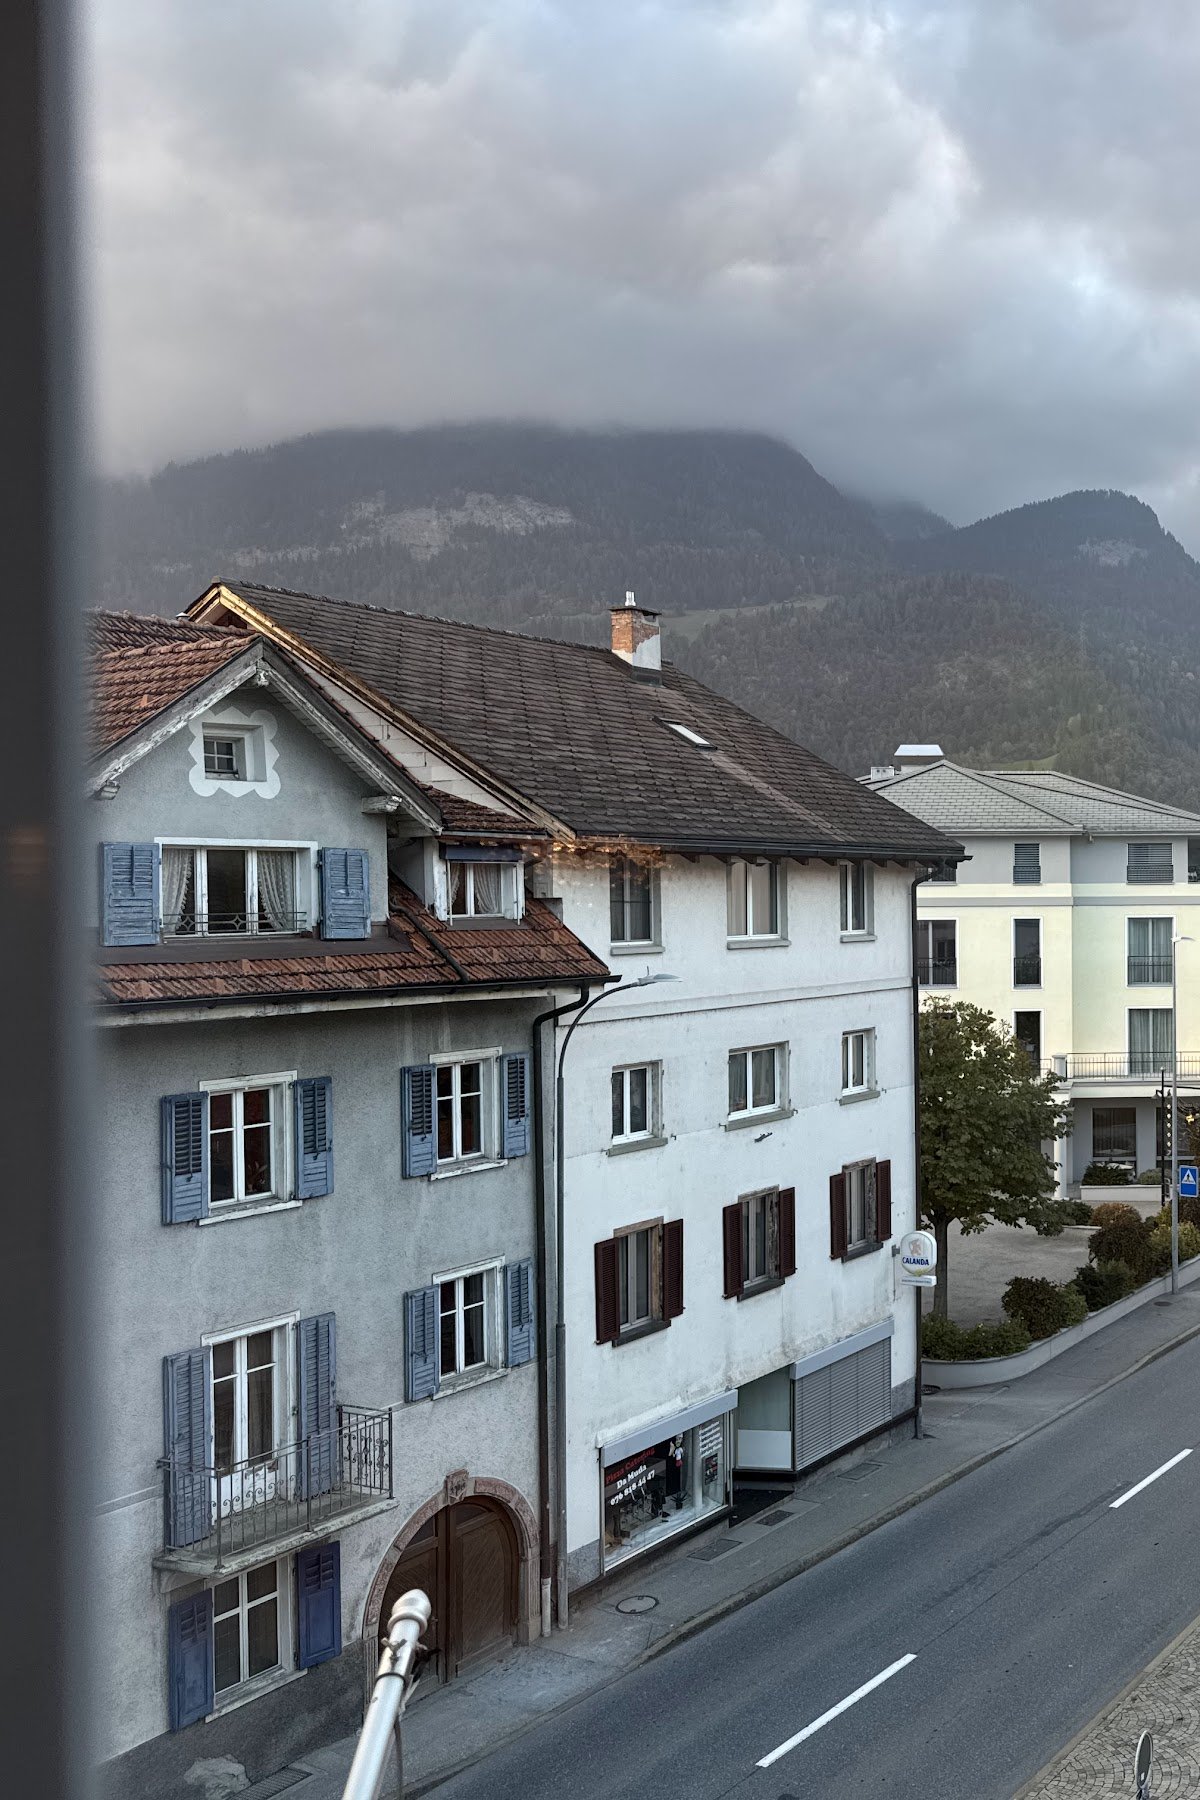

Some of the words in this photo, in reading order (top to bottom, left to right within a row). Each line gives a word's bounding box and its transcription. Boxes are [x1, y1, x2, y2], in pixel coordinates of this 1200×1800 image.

[902, 1256, 930, 1265] CALANDA
[616, 1478, 628, 1490] Da
[610, 1492, 624, 1506] 076
